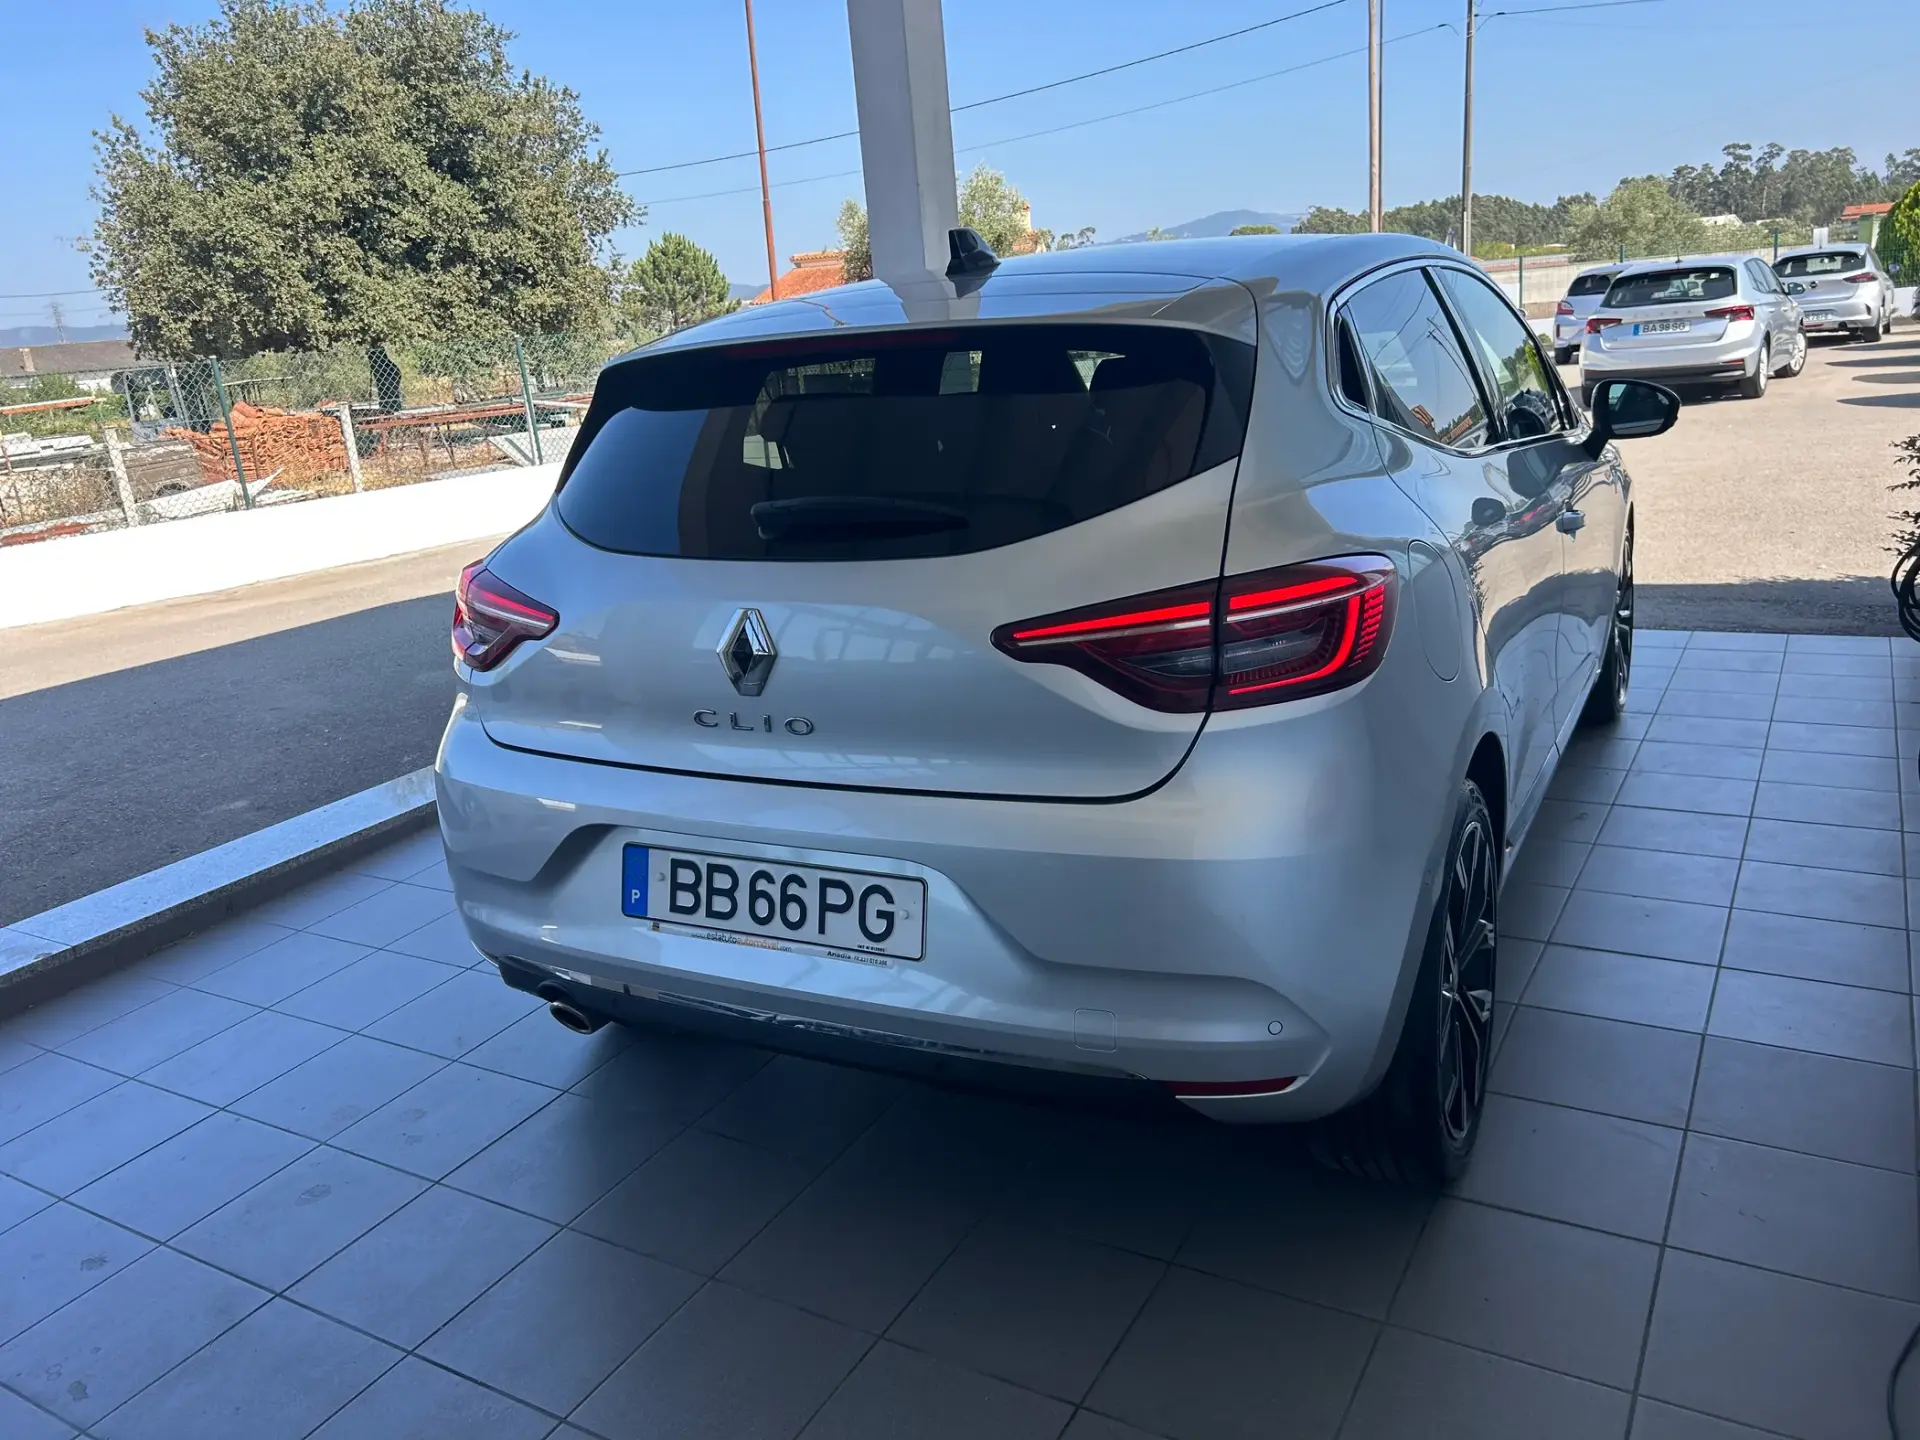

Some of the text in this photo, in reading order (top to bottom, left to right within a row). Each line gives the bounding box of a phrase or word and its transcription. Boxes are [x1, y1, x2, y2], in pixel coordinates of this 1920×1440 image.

[1643, 325, 1657, 333] BA
[693, 709, 815, 736] CLIO
[631, 889, 641, 904] P
[669, 857, 895, 944] BB 66 PG
